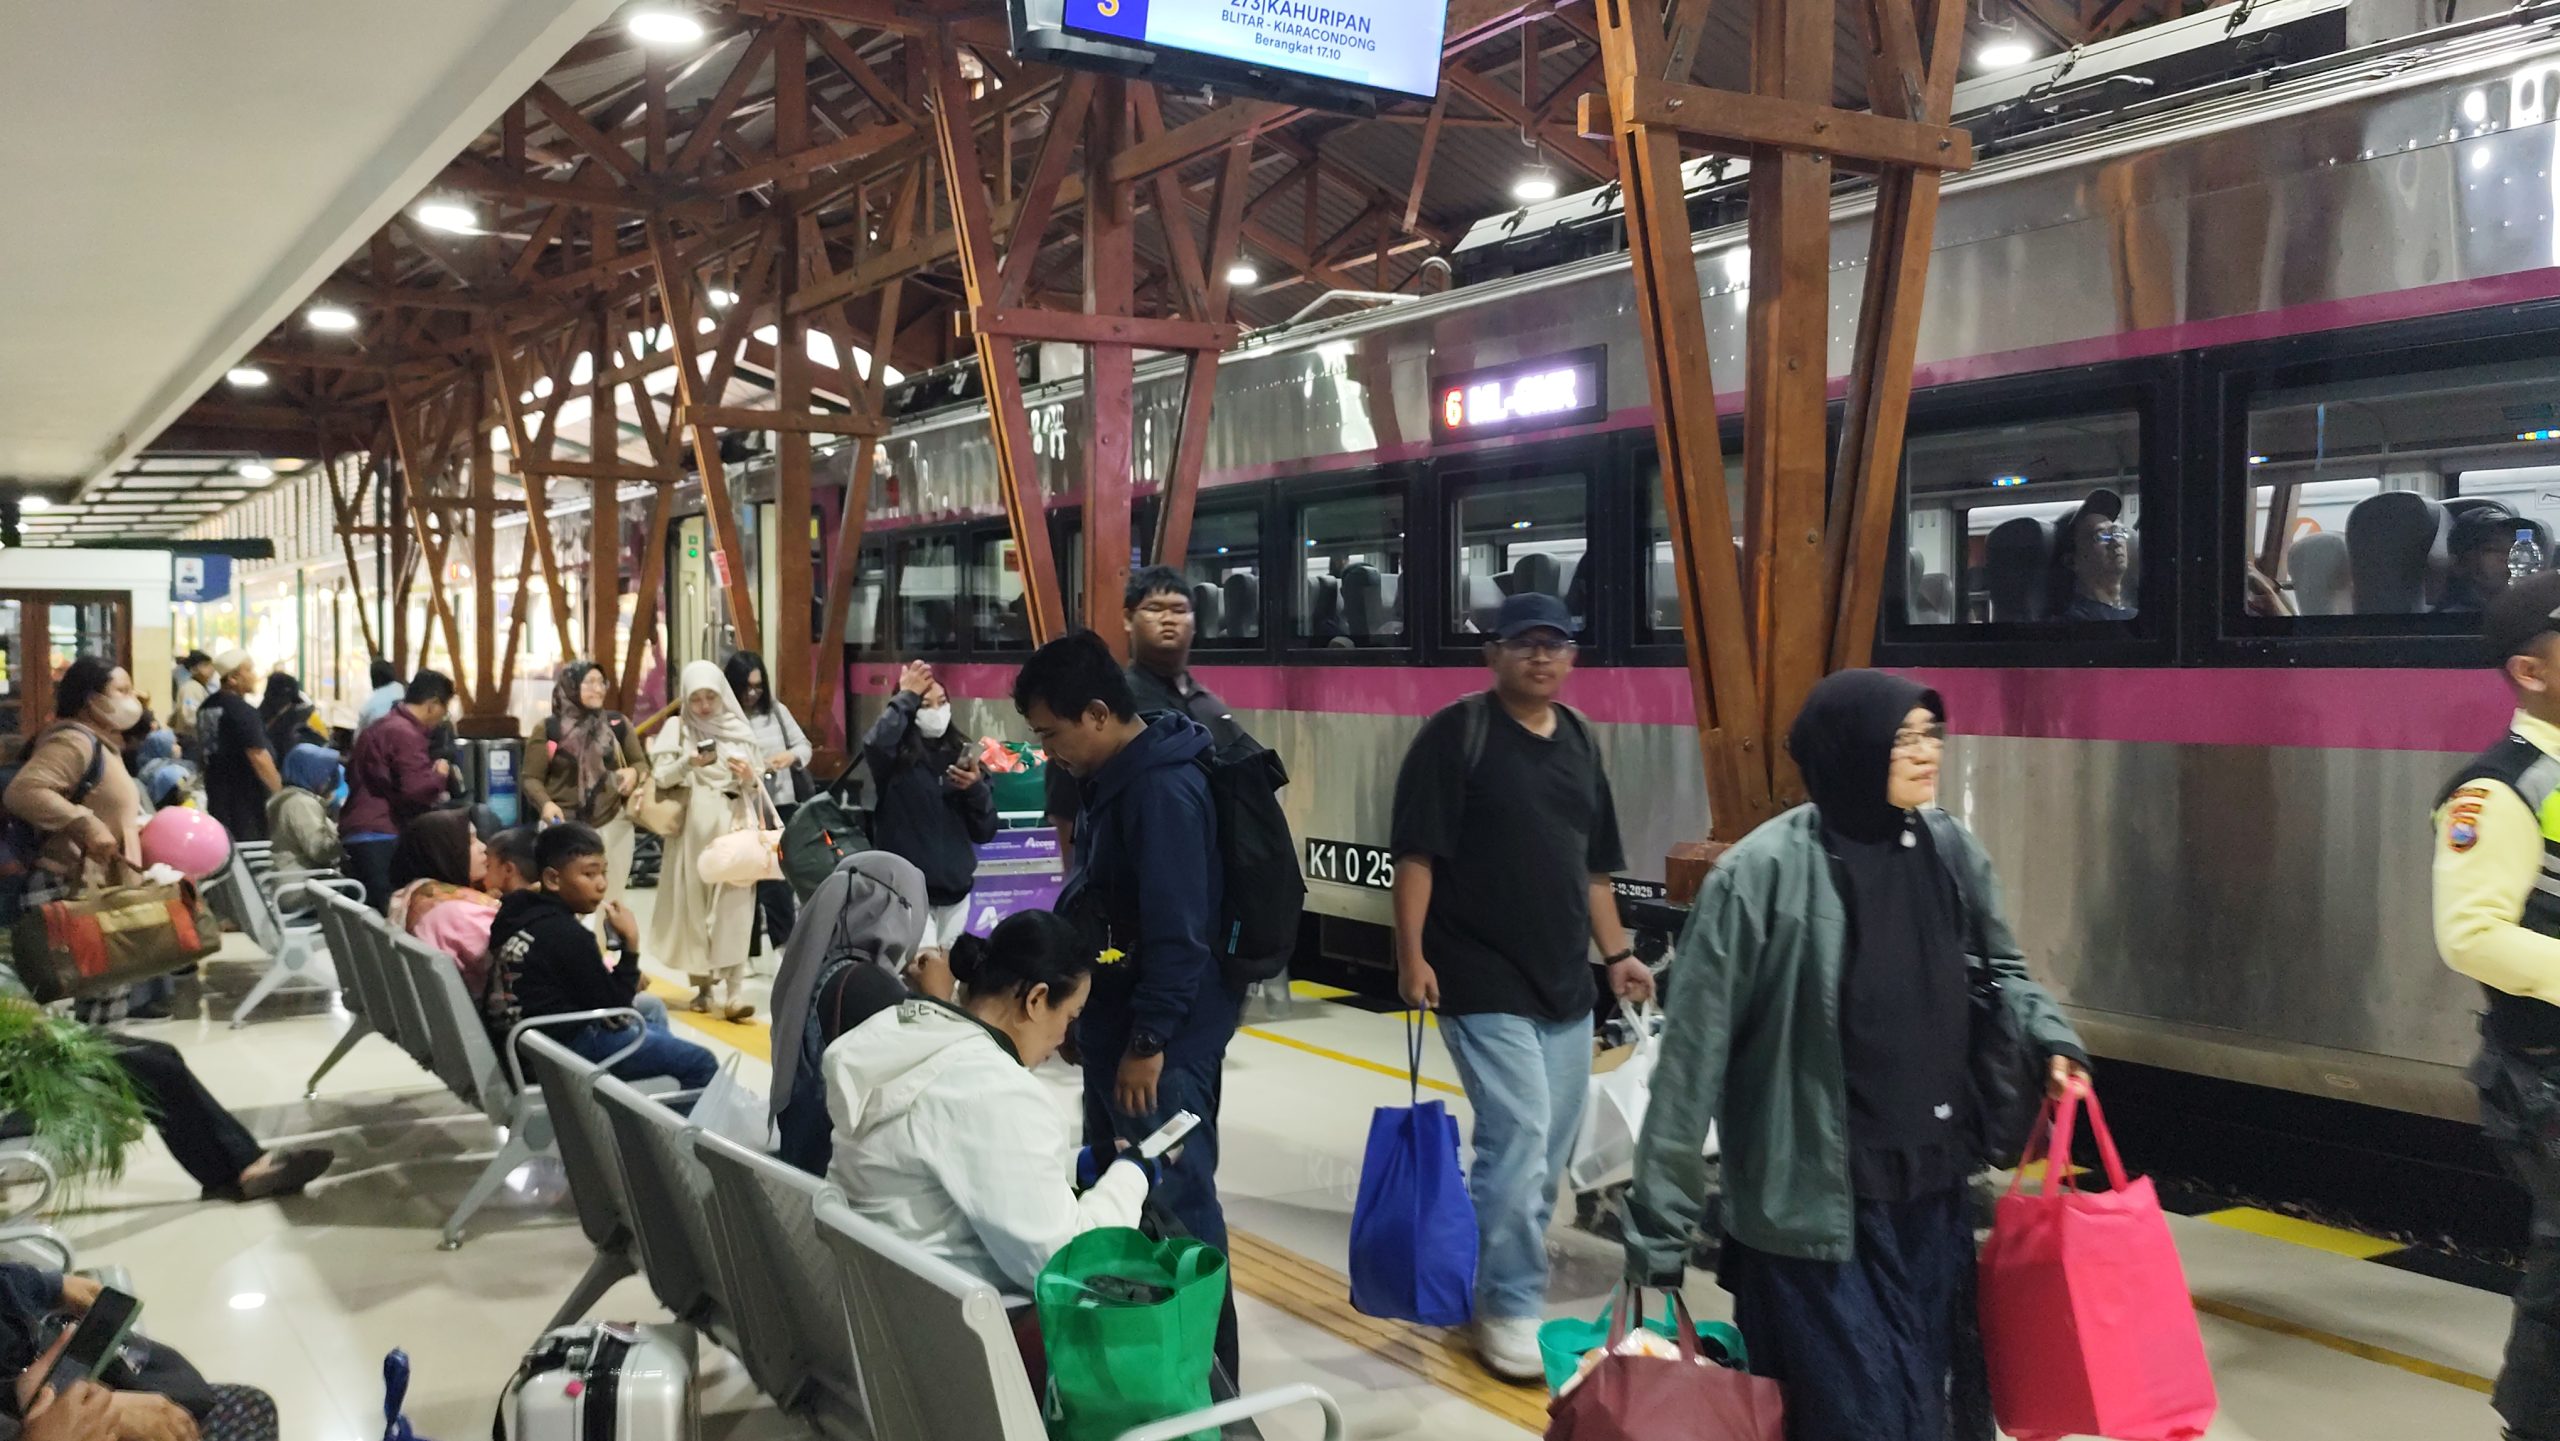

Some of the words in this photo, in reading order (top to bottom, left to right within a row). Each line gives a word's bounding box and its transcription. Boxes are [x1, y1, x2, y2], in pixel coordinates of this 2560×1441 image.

[1221, 9, 1265, 29] BLITAR
[1273, 20, 1376, 52] KIARACONDONG
[1254, 32, 1313, 54] Berangkat
[1316, 46, 1341, 60] 17.10
[1310, 842, 1337, 879] K1
[1345, 847, 1360, 883] 0
